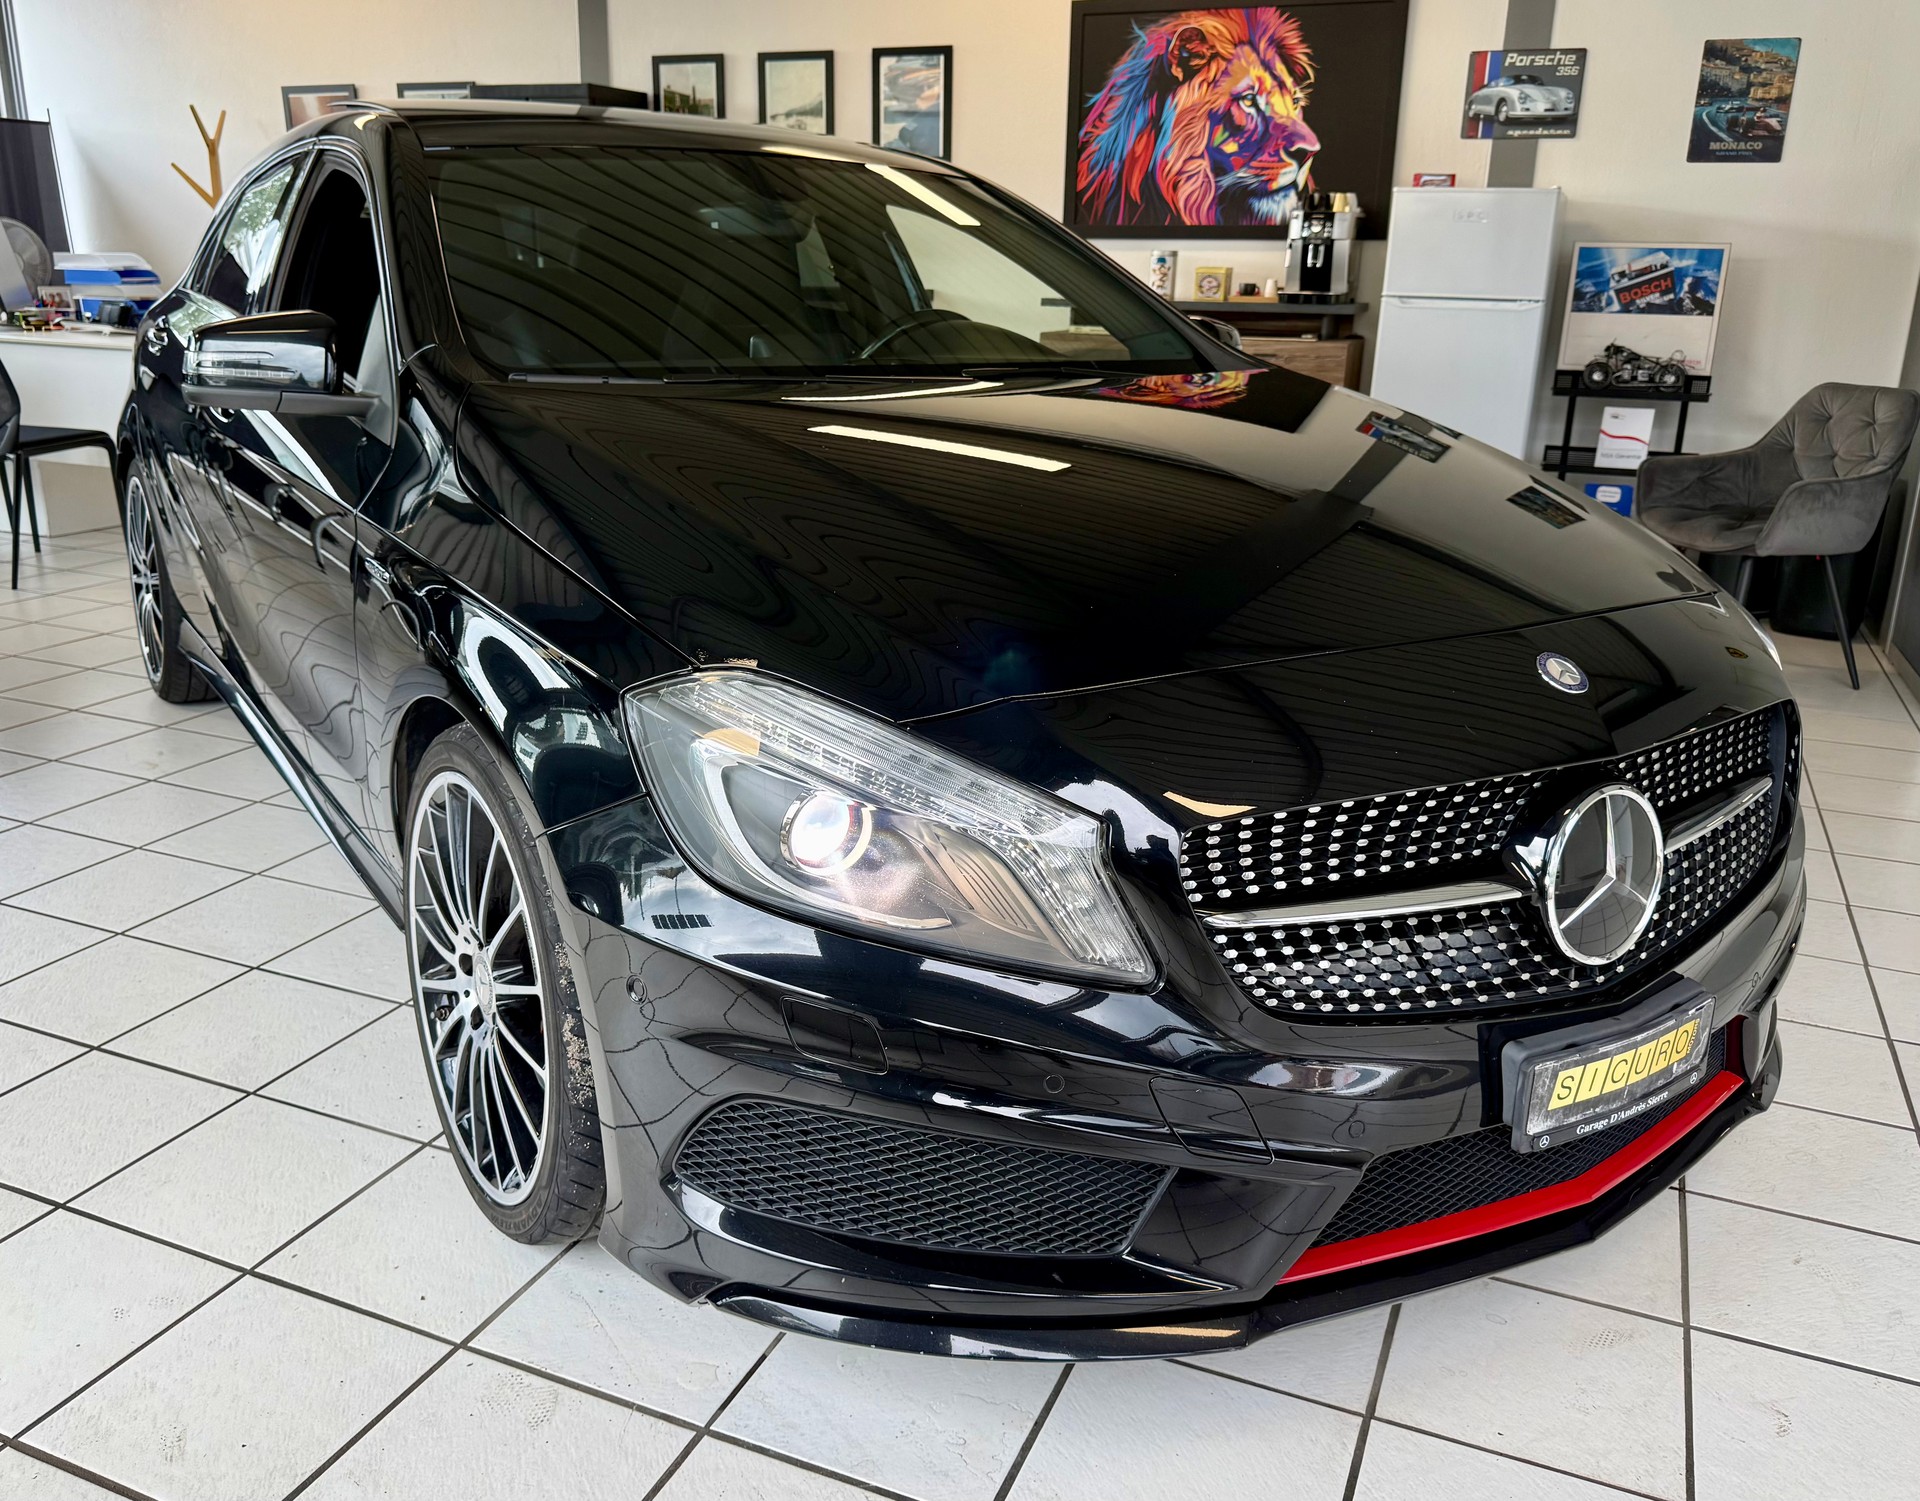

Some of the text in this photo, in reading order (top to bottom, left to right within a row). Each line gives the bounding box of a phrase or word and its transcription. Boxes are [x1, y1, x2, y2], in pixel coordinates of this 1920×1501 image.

[1504, 51, 1576, 66] Porsche
[1555, 66, 1580, 76] 356
[1709, 141, 1763, 150] MONACO
[1619, 277, 1673, 304] BOSCH
[1686, 1018, 1700, 1054] MOTORS
[1556, 1029, 1689, 1101] SICURO
[1576, 1118, 1609, 1135] Garage
[1646, 1091, 1669, 1107] Sierre
